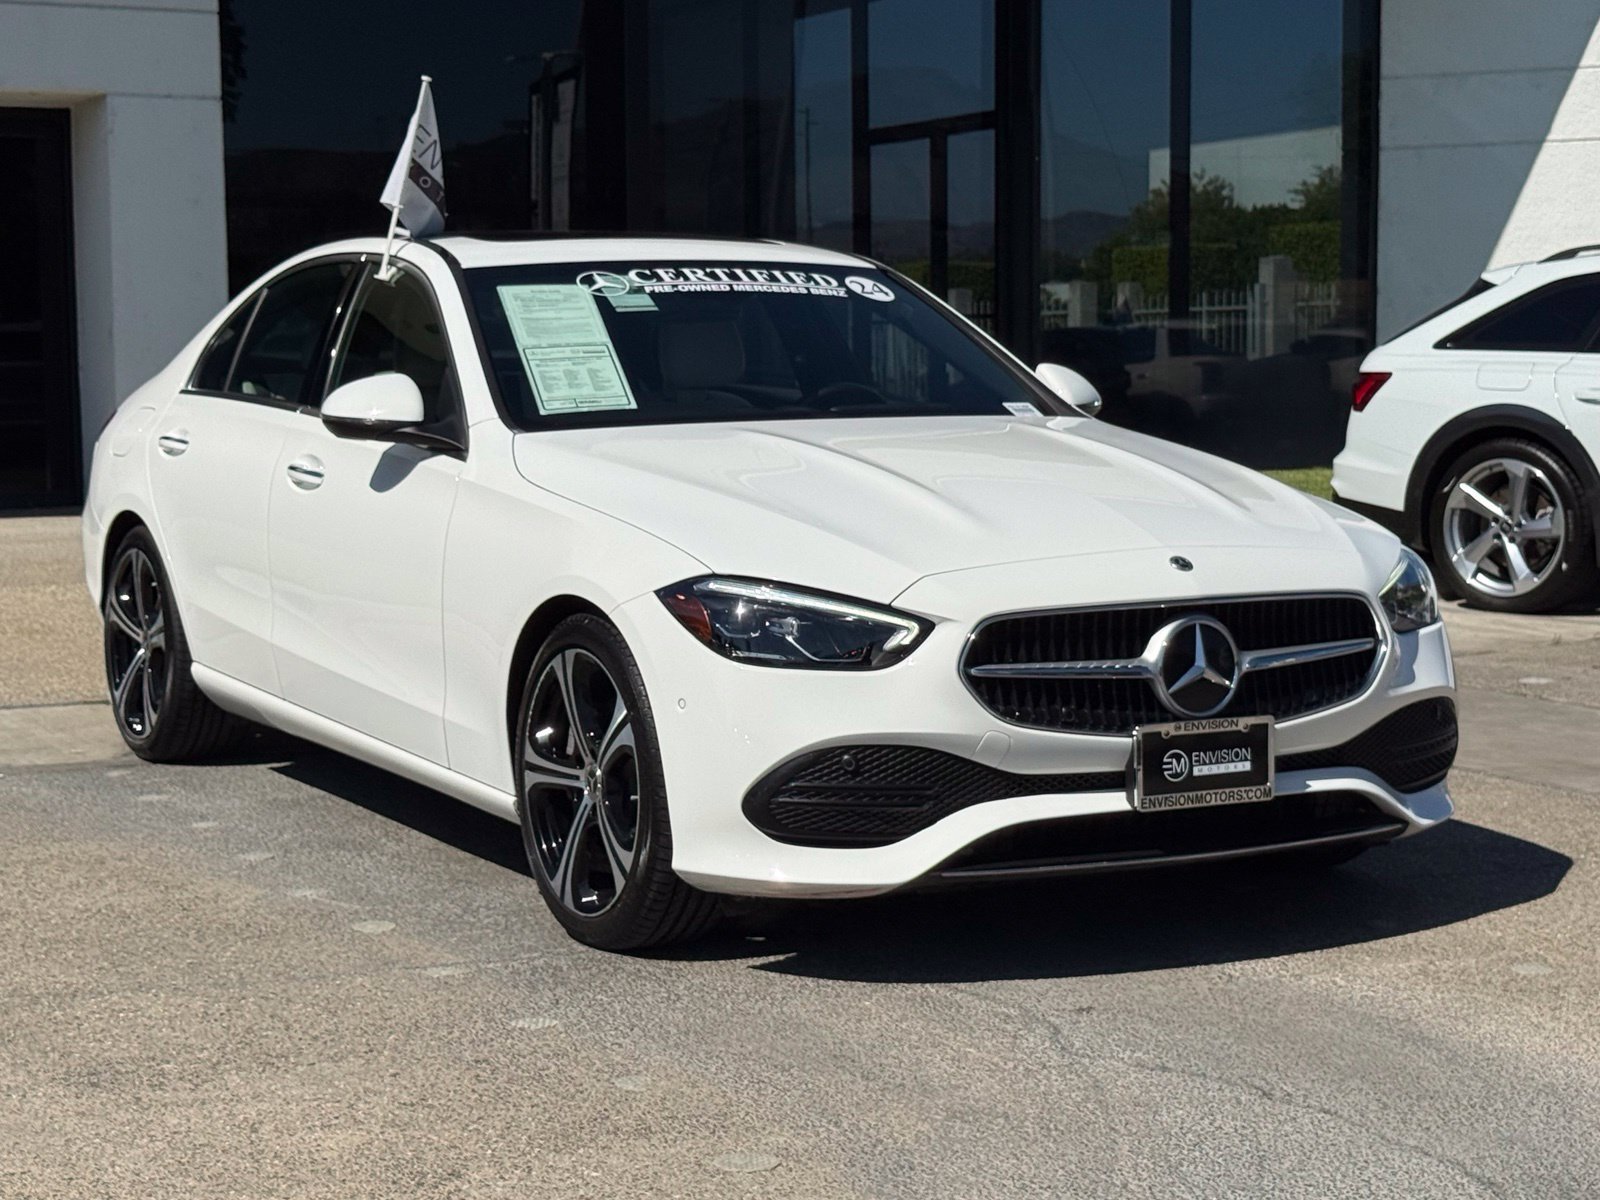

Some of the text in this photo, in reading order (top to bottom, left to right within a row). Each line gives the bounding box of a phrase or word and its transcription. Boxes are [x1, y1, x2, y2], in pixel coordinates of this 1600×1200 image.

[628, 268, 839, 288] CERTIFIED
[644, 284, 848, 298] PRE-OWNED MERCEDES BENZ
[850, 280, 890, 297] 24
[1183, 719, 1239, 731] ENVISION
[1191, 747, 1251, 766] ENVISION
[1197, 763, 1247, 773] MOTORS
[1141, 787, 1272, 809] ENVISIONMOTORS.COM
